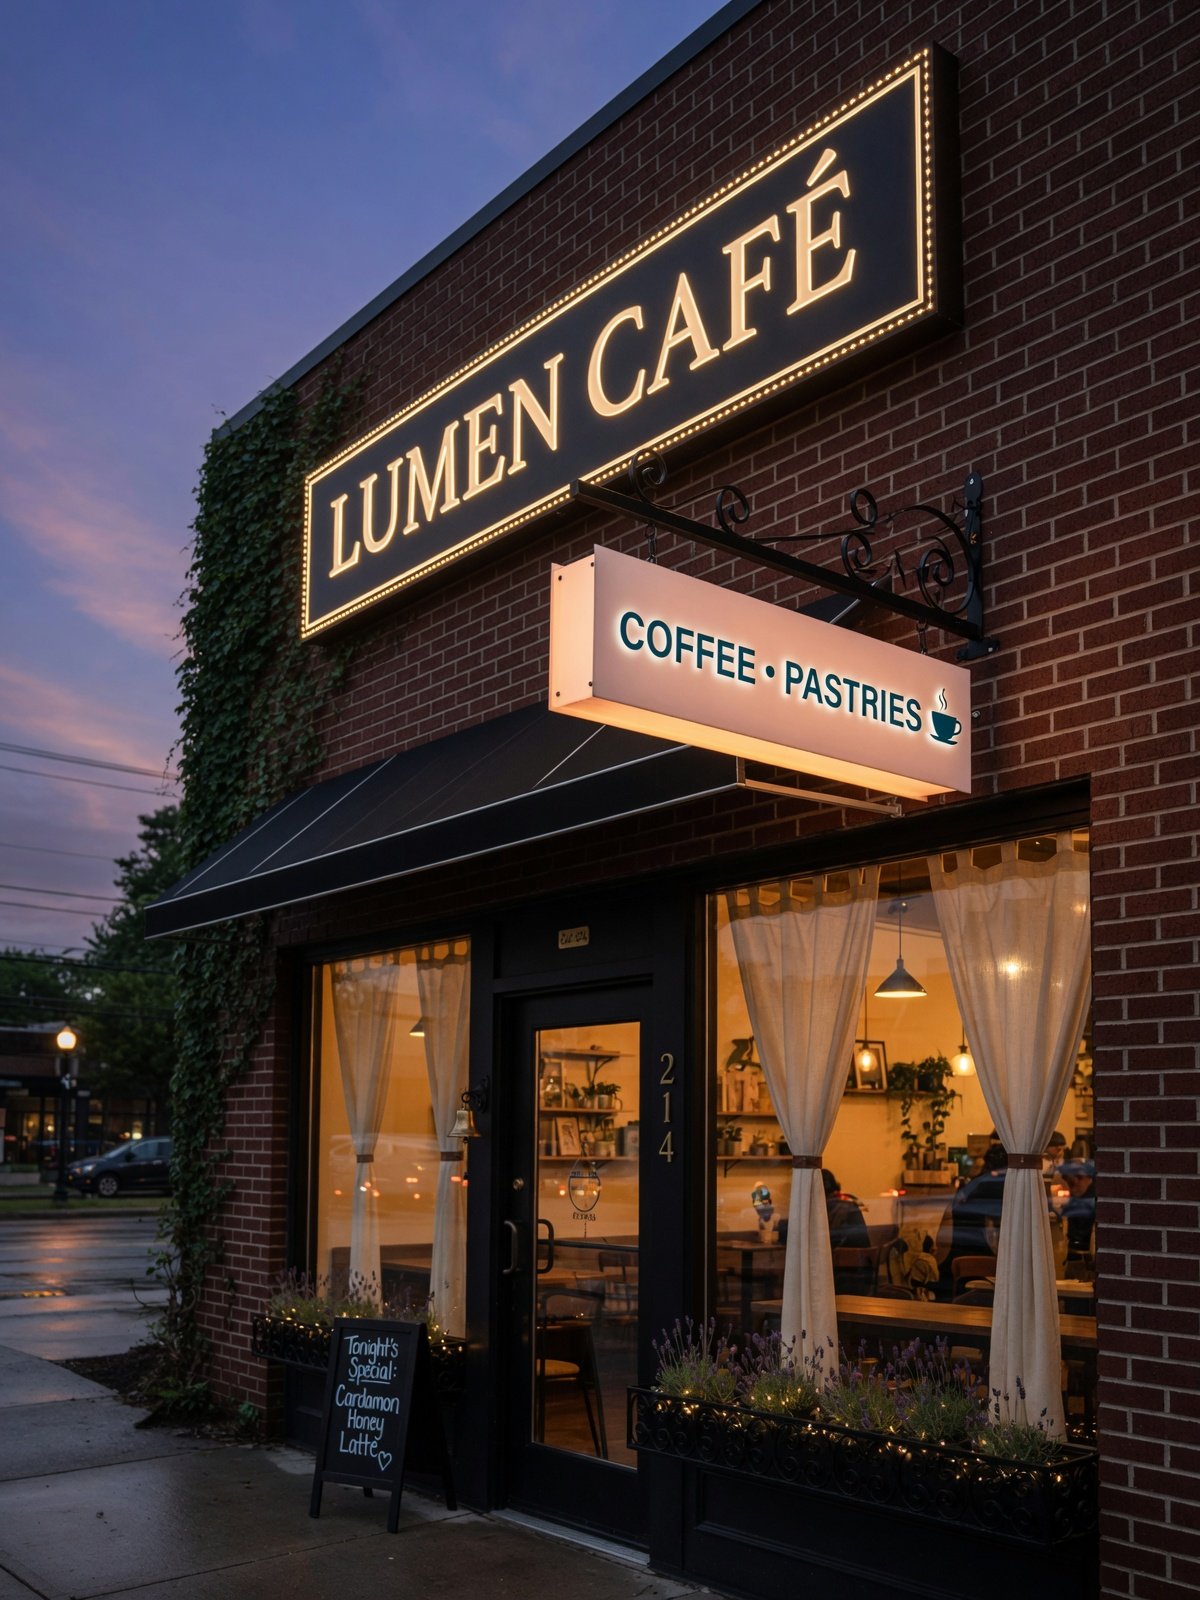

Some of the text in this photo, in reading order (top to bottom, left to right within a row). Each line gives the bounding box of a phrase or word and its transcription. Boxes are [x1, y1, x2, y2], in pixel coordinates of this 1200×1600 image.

[329, 148, 857, 578] LUMEN CAFÉ
[619, 611, 756, 685] COFFEE
[785, 660, 922, 732] PASTRIES
[344, 1335, 399, 1365] Tonight's
[348, 1357, 398, 1385] Special:
[335, 1384, 400, 1414] Cardamon
[347, 1408, 385, 1440] Honey
[339, 1430, 378, 1458] Latte
